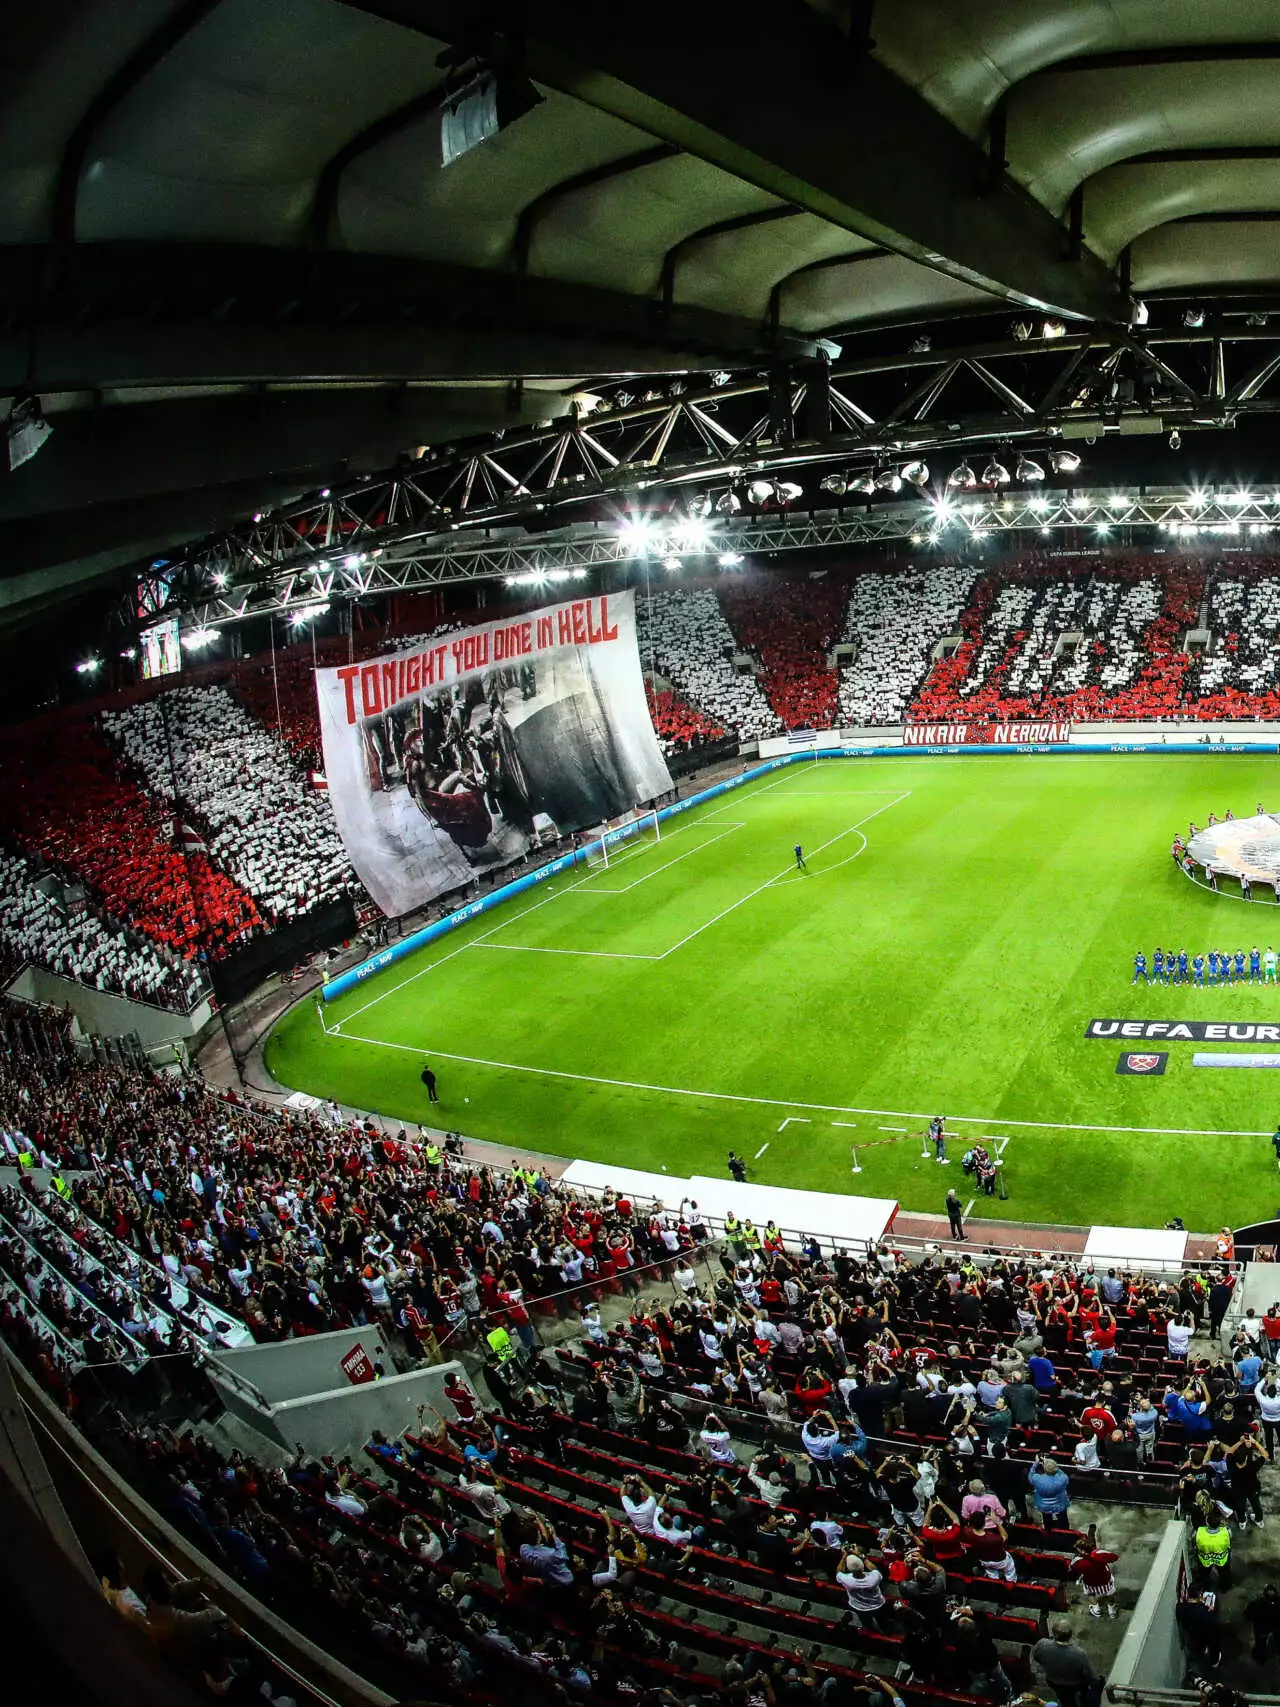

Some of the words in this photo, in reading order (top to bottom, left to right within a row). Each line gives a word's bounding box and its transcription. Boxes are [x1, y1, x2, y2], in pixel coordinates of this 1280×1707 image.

[337, 644, 448, 725] TONIGHT
[452, 631, 489, 675] YOU
[494, 622, 532, 661] DINE
[537, 615, 553, 650] IN
[558, 596, 619, 645] HELL
[1092, 1021, 1194, 1038] UEFA
[354, 1363, 366, 1378] 133
